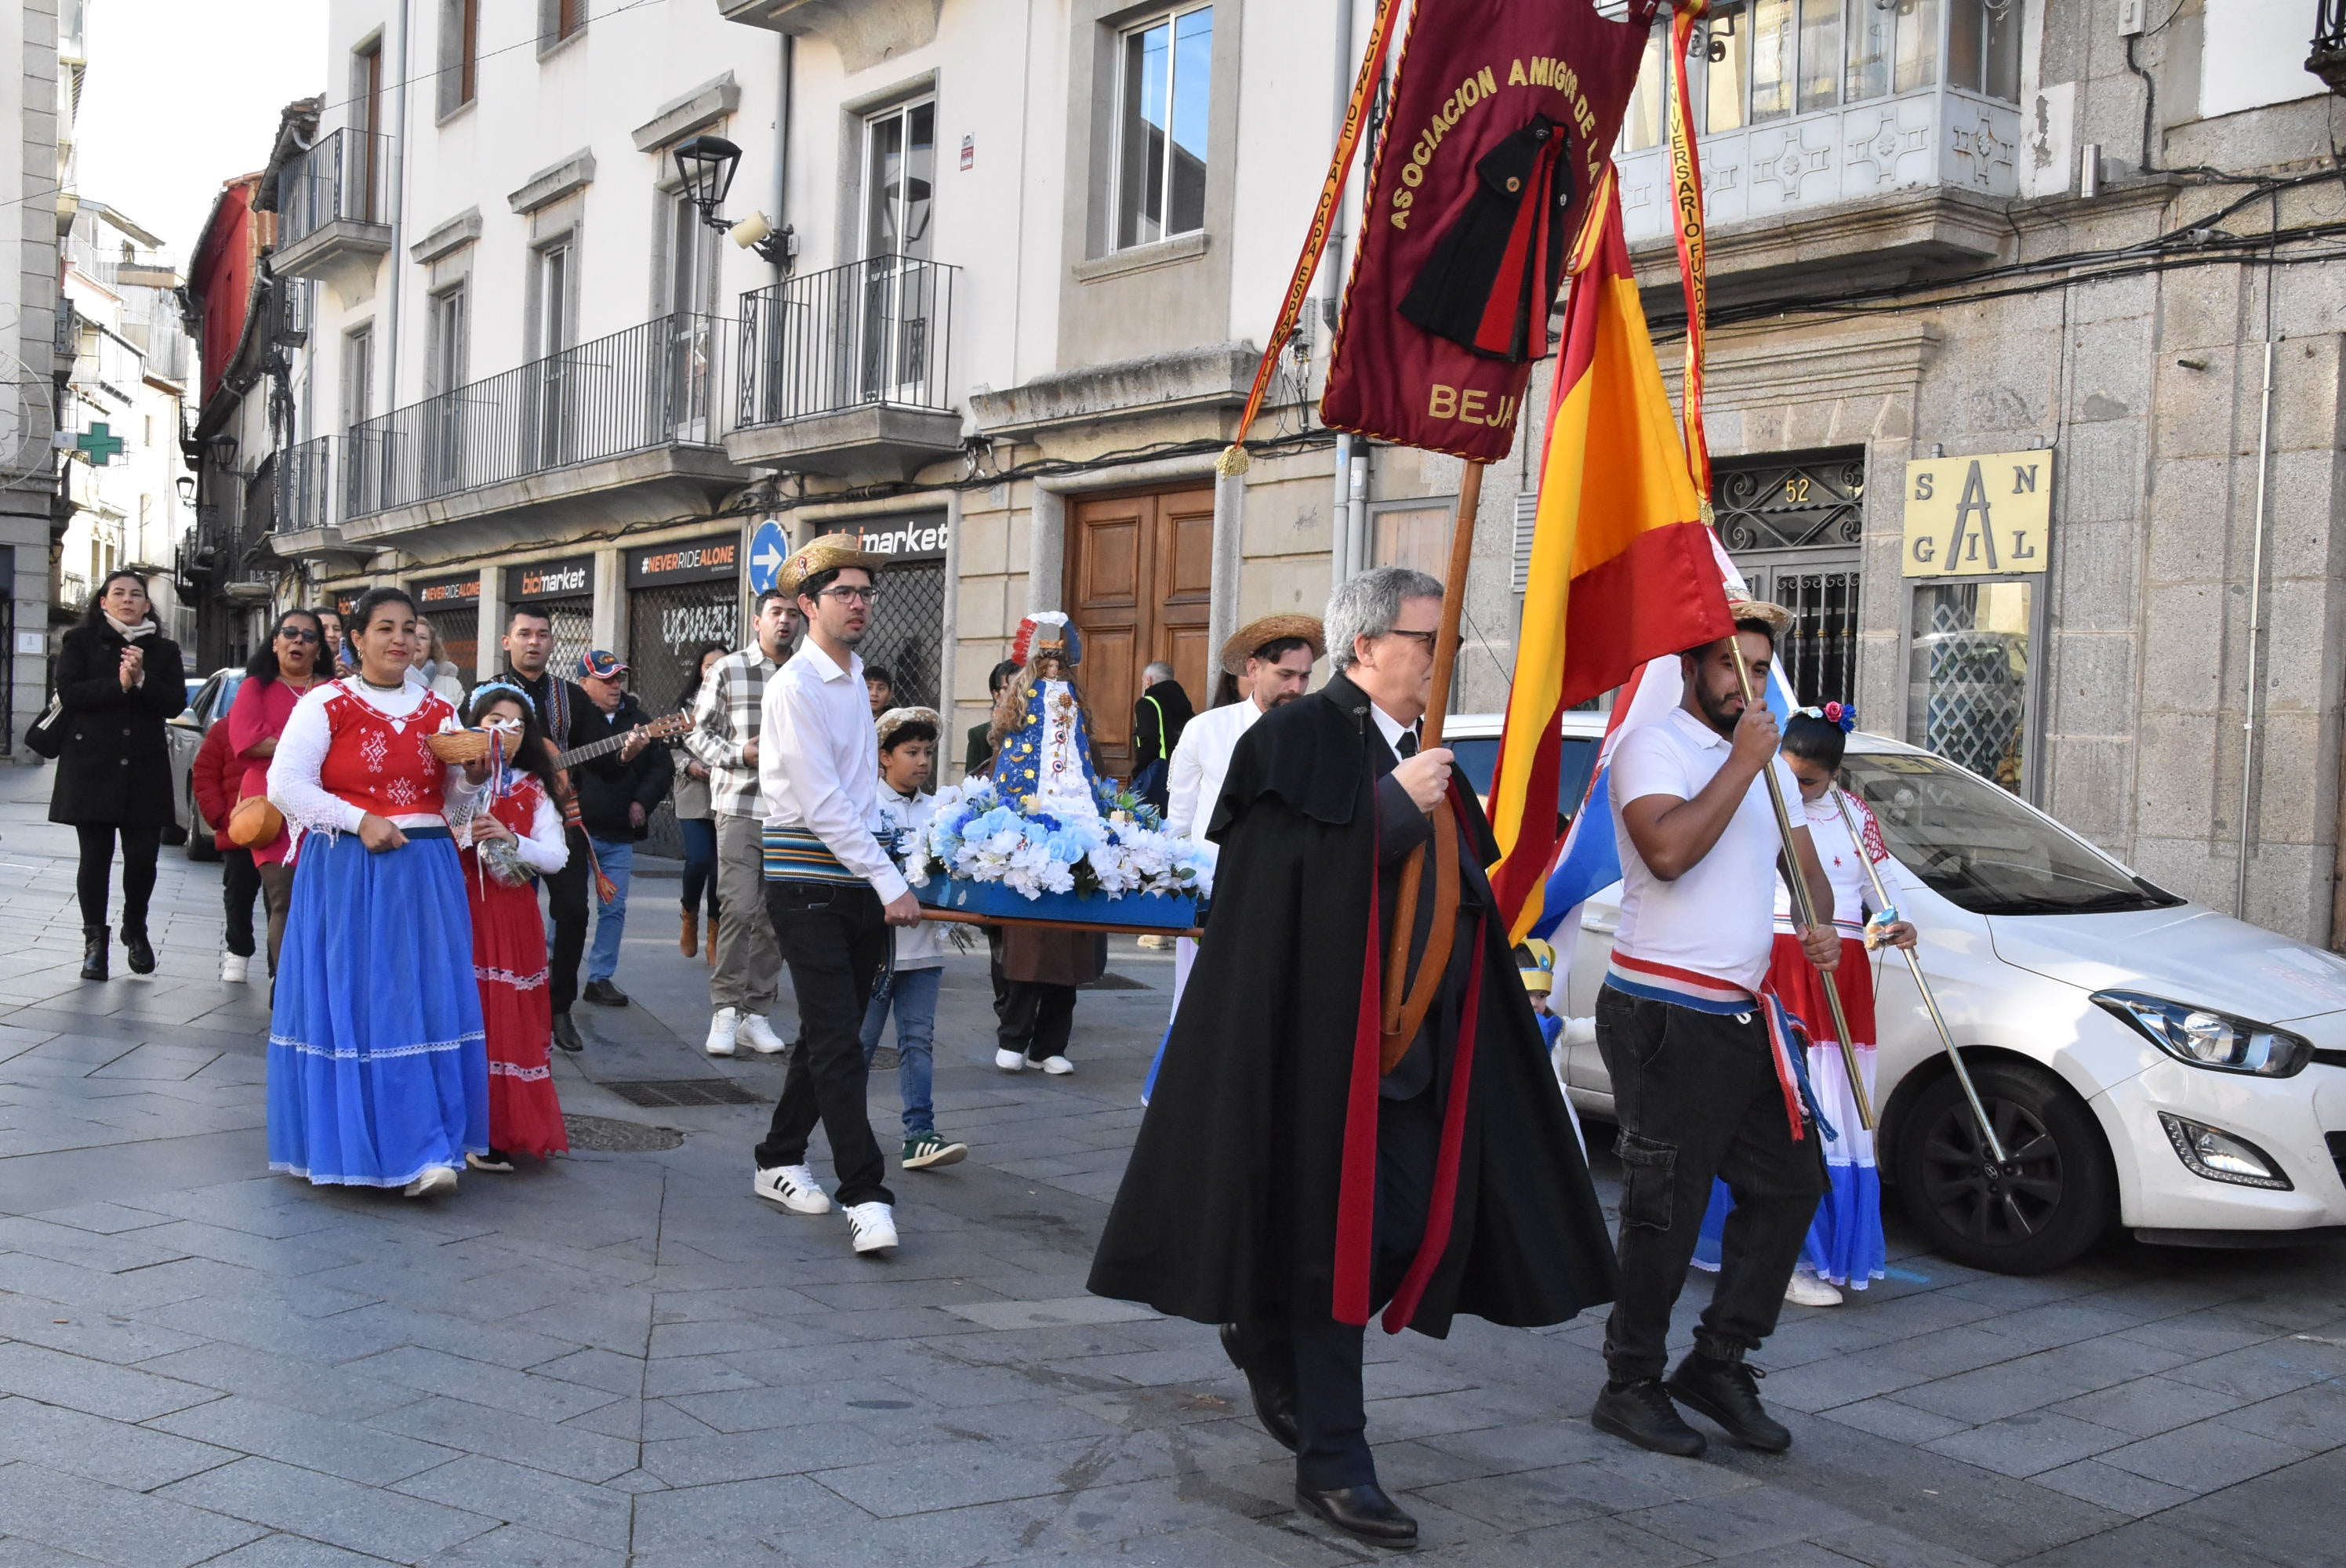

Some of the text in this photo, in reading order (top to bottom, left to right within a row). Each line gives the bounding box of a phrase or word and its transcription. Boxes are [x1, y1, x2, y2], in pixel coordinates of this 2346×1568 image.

[1356, 29, 1380, 96] CUNA
[1344, 104, 1357, 140] DE
[1391, 56, 1601, 230] ASOCIACION AMIGOS DE LA
[1670, 76, 1701, 238] ANIVERSARIO
[1327, 149, 1341, 183] LA
[1307, 193, 1331, 258] CAPA
[1786, 478, 1810, 503] 52
[829, 521, 949, 554] imarket
[641, 545, 735, 575] #NEVERRIDEALONE
[521, 566, 586, 594] bicimarket
